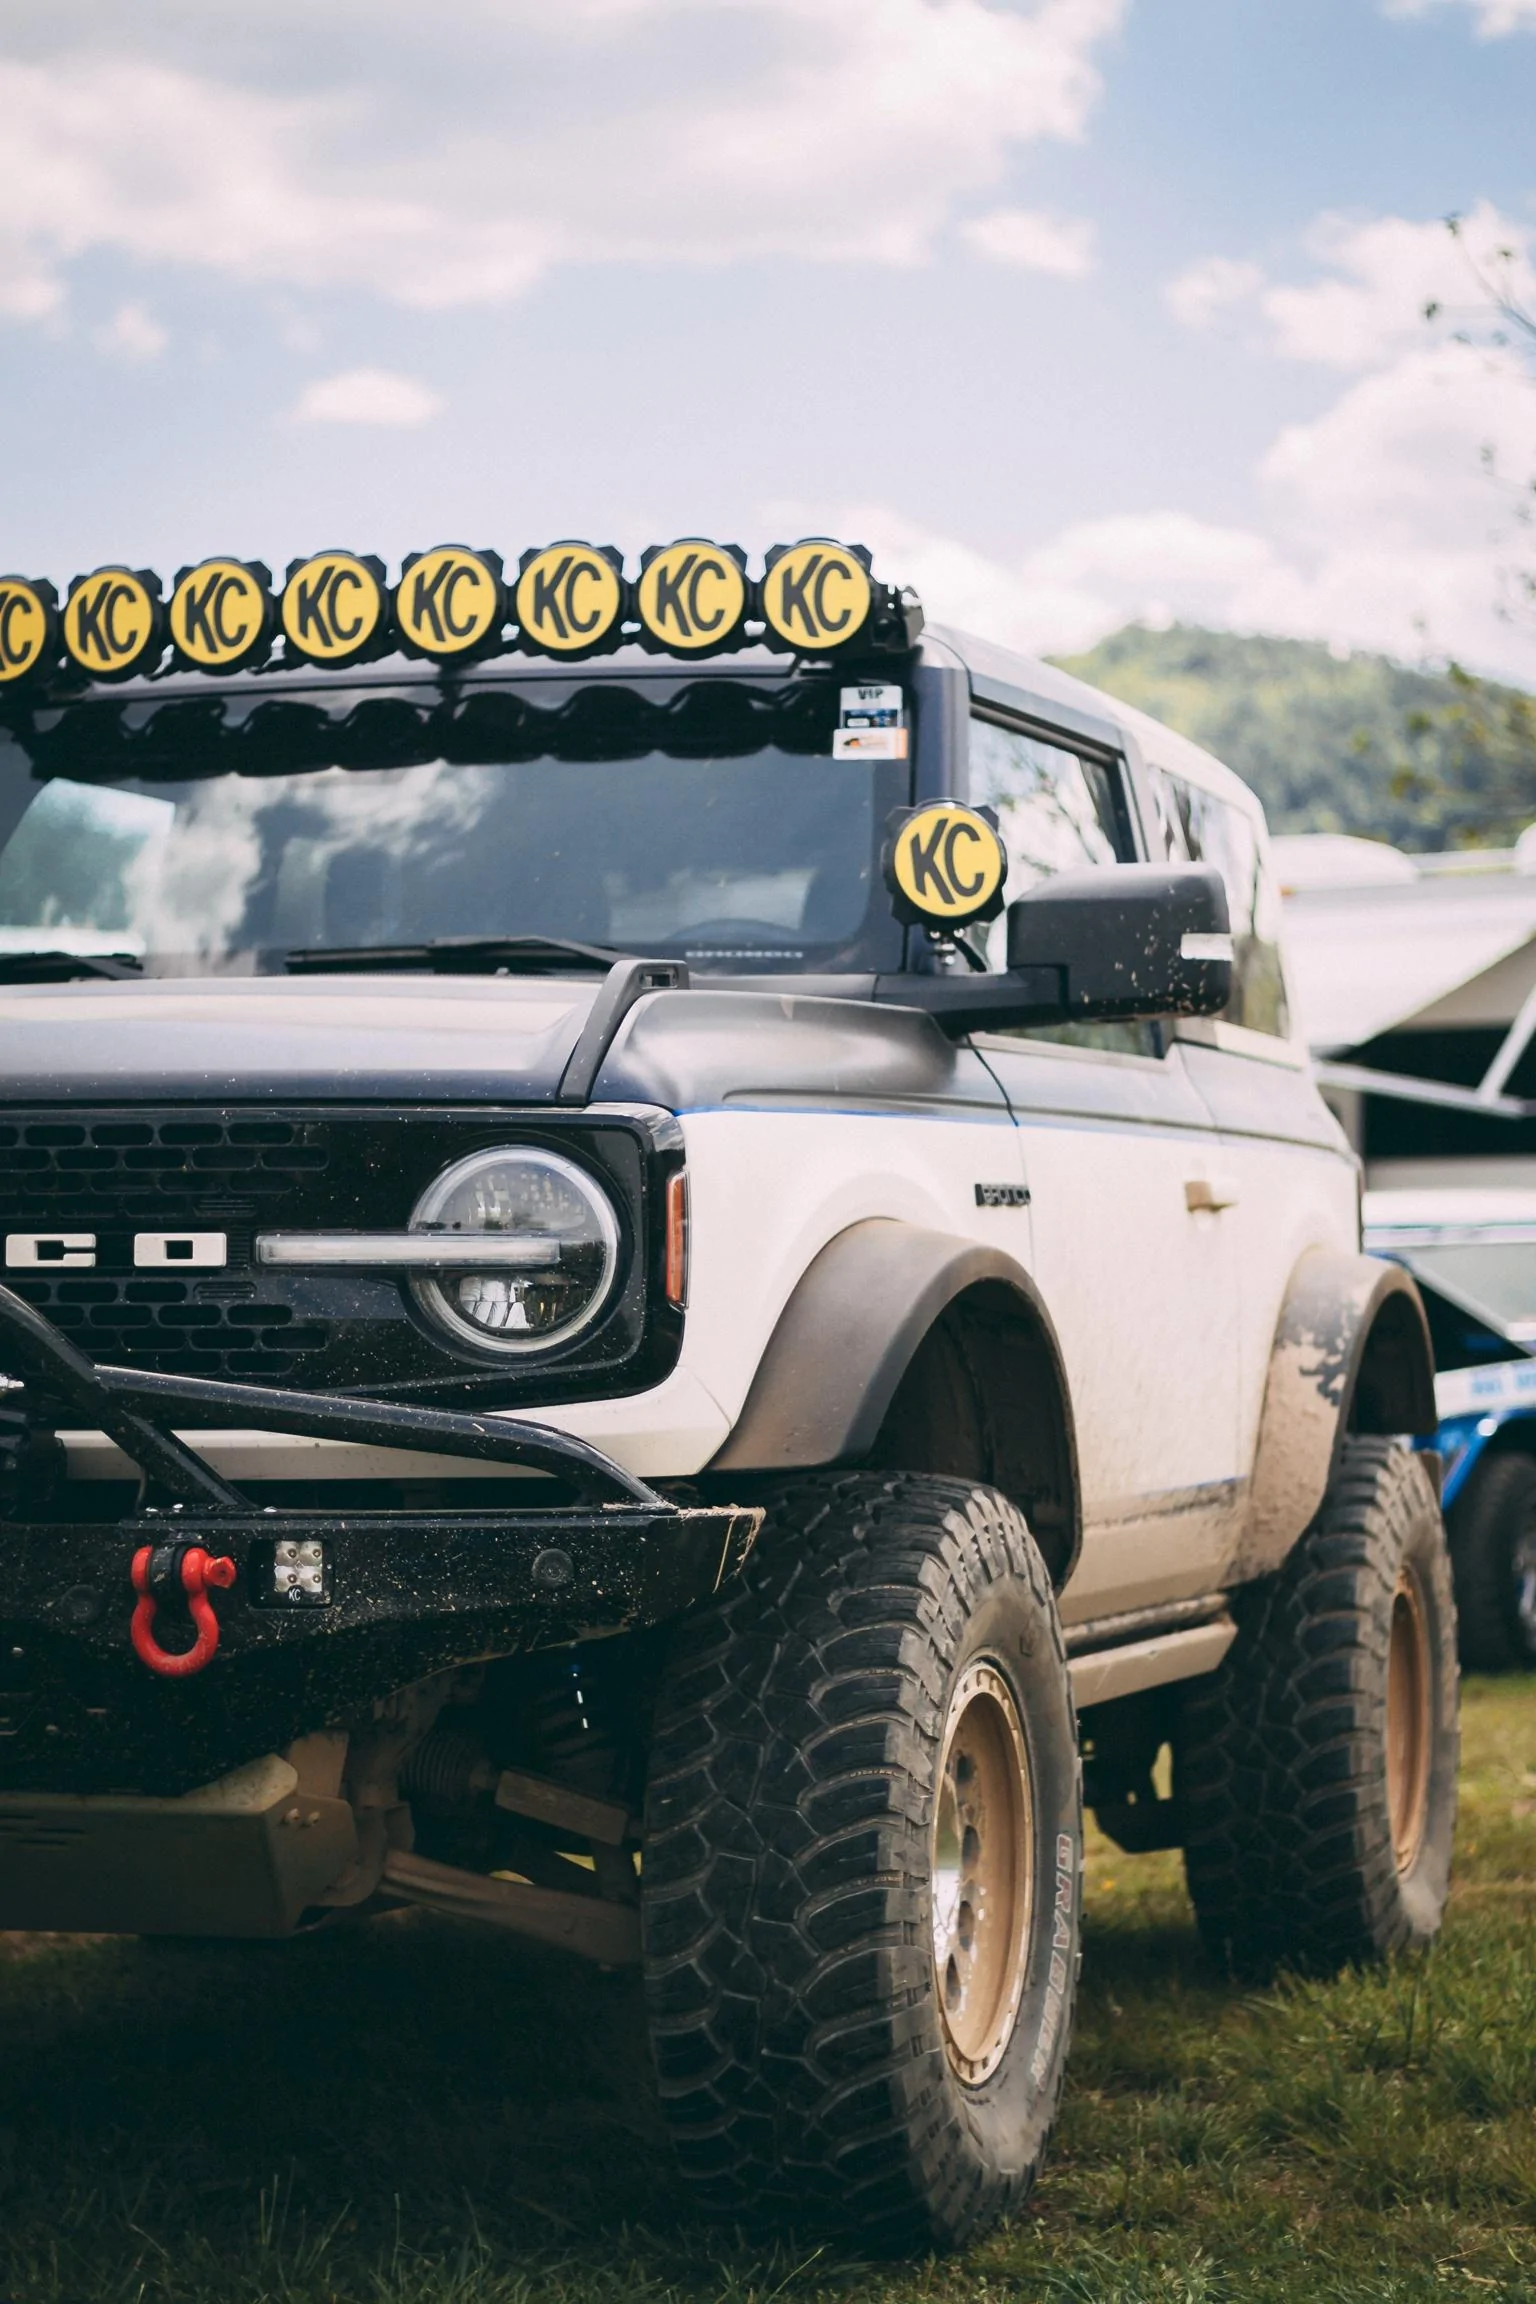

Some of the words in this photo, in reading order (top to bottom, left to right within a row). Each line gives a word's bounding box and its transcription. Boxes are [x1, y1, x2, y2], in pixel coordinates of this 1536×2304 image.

[78, 581, 137, 661] KC
[185, 573, 248, 653] KC
[298, 566, 363, 647] KC
[412, 560, 480, 642] KC
[534, 556, 602, 638] KC
[657, 554, 726, 636] KC
[782, 554, 852, 638] KC
[858, 688, 883, 700] VIP
[910, 818, 985, 905] KC
[289, 1588, 301, 1601] KC
